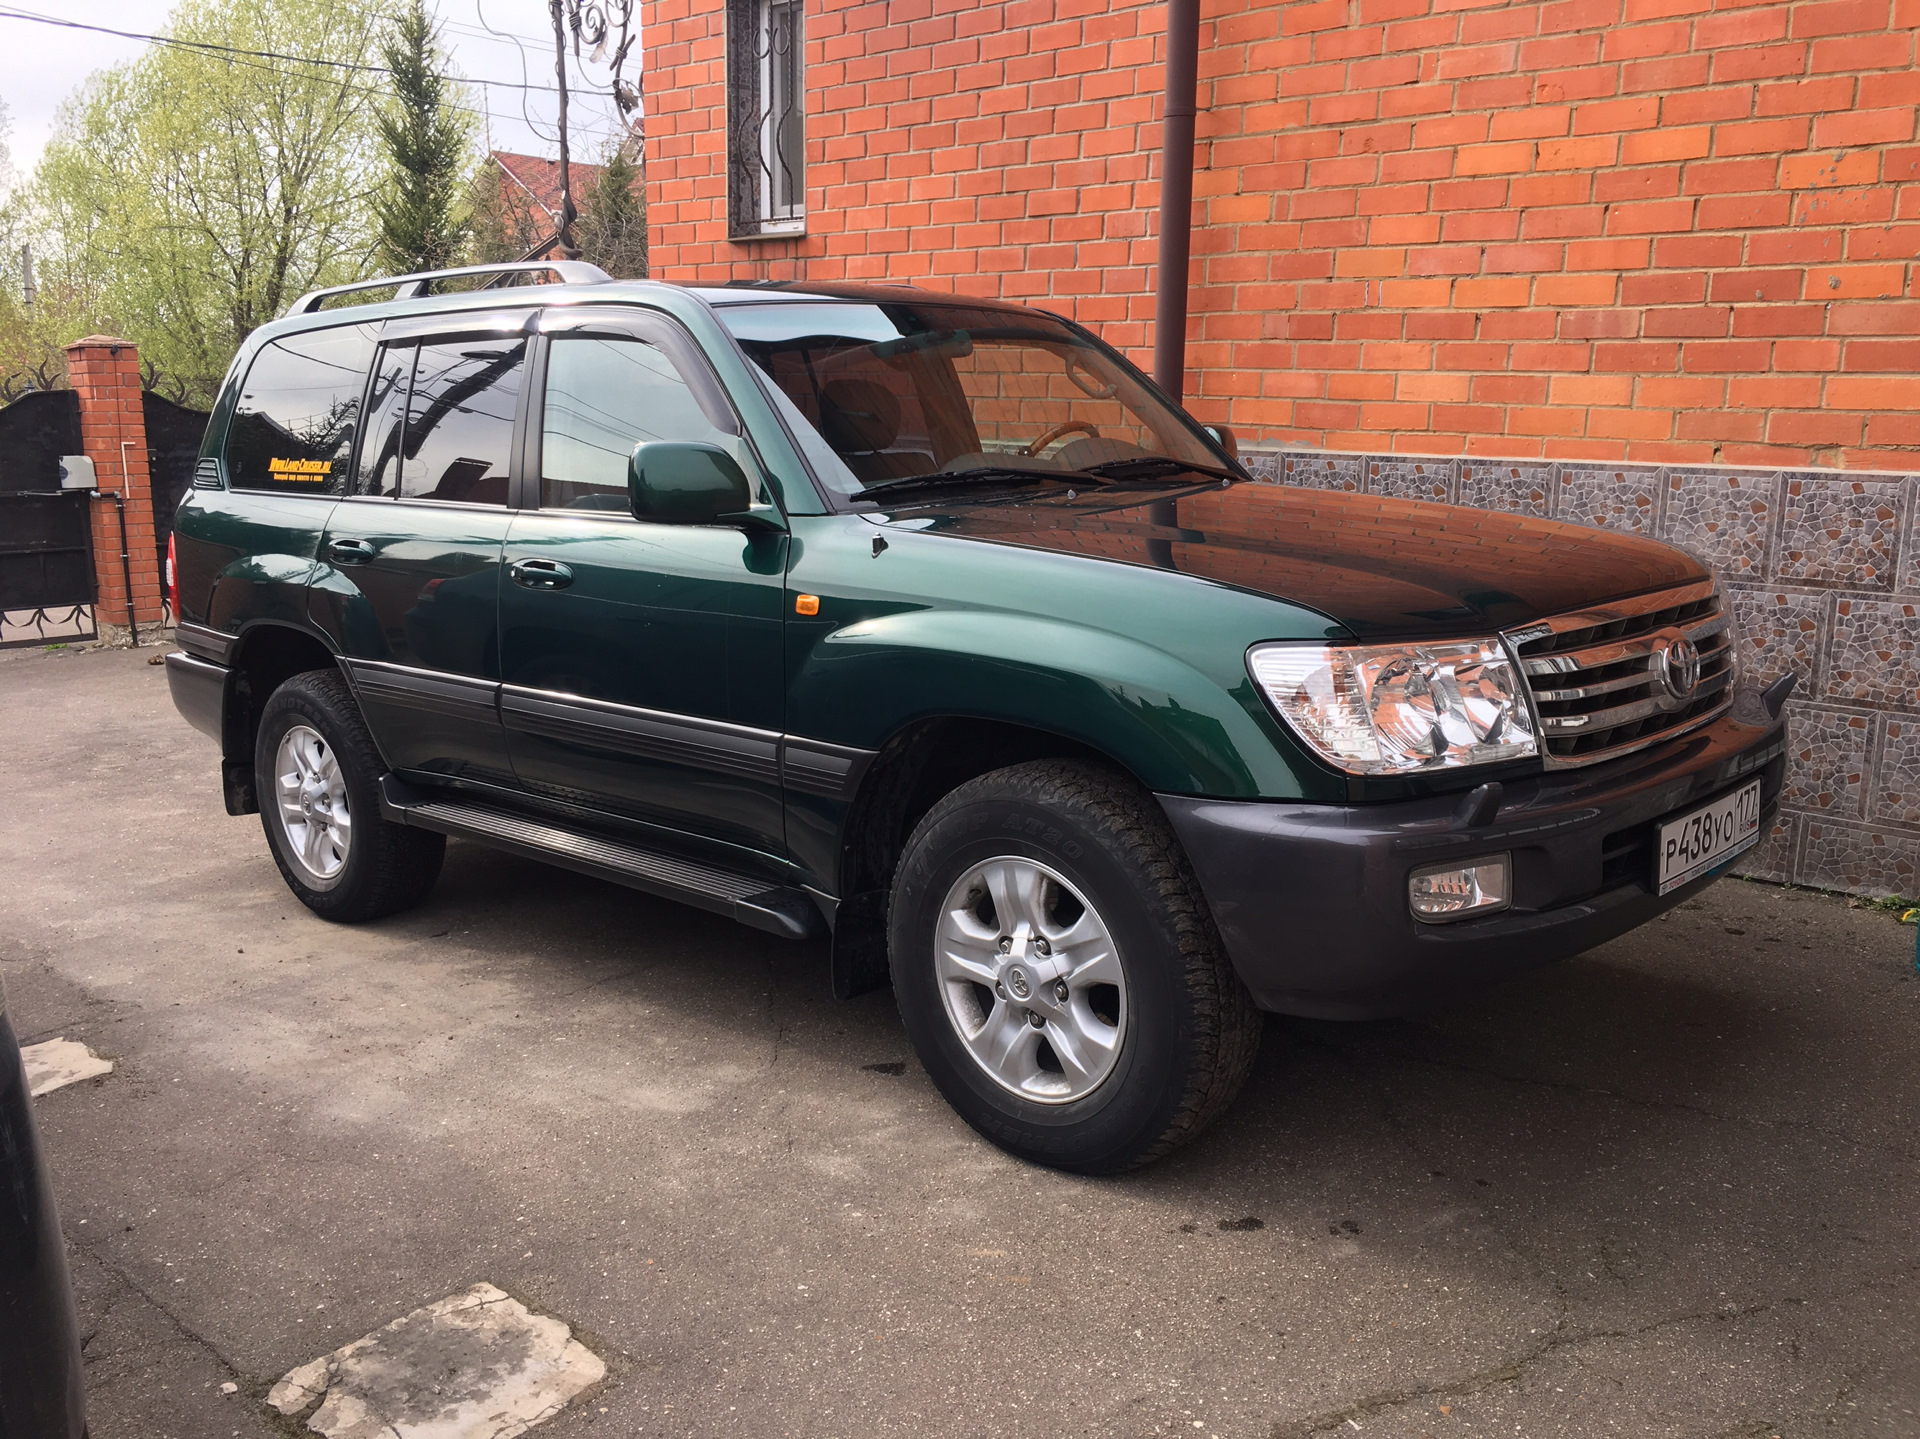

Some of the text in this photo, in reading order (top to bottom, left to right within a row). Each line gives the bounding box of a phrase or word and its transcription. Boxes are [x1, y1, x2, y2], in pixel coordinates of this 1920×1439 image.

[1736, 784, 1757, 823] 177
[1001, 812, 1085, 859] AT20
[1740, 819, 1750, 834] RUS
